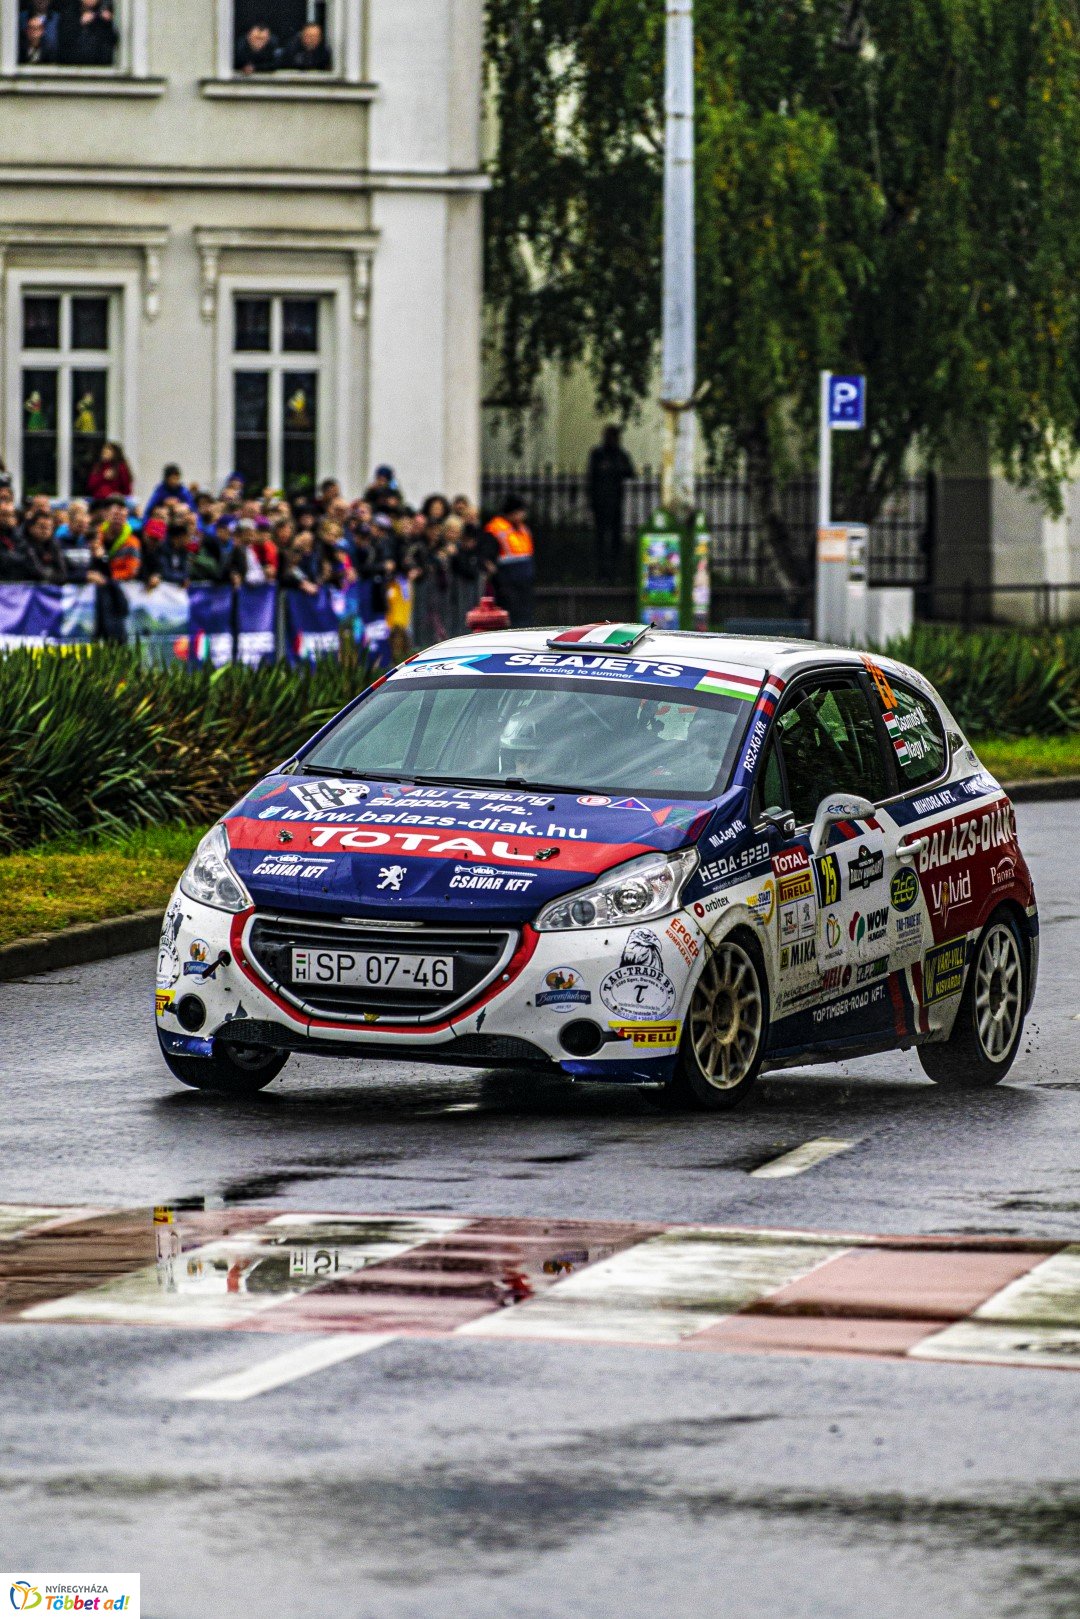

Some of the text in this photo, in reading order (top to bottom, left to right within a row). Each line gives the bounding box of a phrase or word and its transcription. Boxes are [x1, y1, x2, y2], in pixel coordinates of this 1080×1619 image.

[833, 382, 857, 413] P
[504, 654, 684, 678] SEAJETS
[539, 667, 574, 675] Racing
[590, 670, 634, 679] summer
[365, 797, 471, 809] Support
[404, 789, 555, 807] Alu Casting
[281, 809, 588, 839] www.balazs-diak.hu
[919, 801, 1015, 874] BALÁZS-DIÁK
[310, 826, 534, 861] TOTAL
[252, 863, 329, 878] CSAVAR KFT
[771, 851, 807, 873] TOTAL
[449, 875, 533, 892] CSAVAR KFT
[780, 873, 812, 901] PIRELLI
[820, 855, 837, 905] 25
[705, 895, 730, 913] orbitex
[866, 906, 889, 932] WOW
[671, 917, 699, 957] ÉPGÉP
[791, 939, 816, 967] MIKA
[295, 967, 306, 980] H
[316, 953, 448, 988] SP 07-46
[603, 966, 675, 1000] TAU-TRADE BT.
